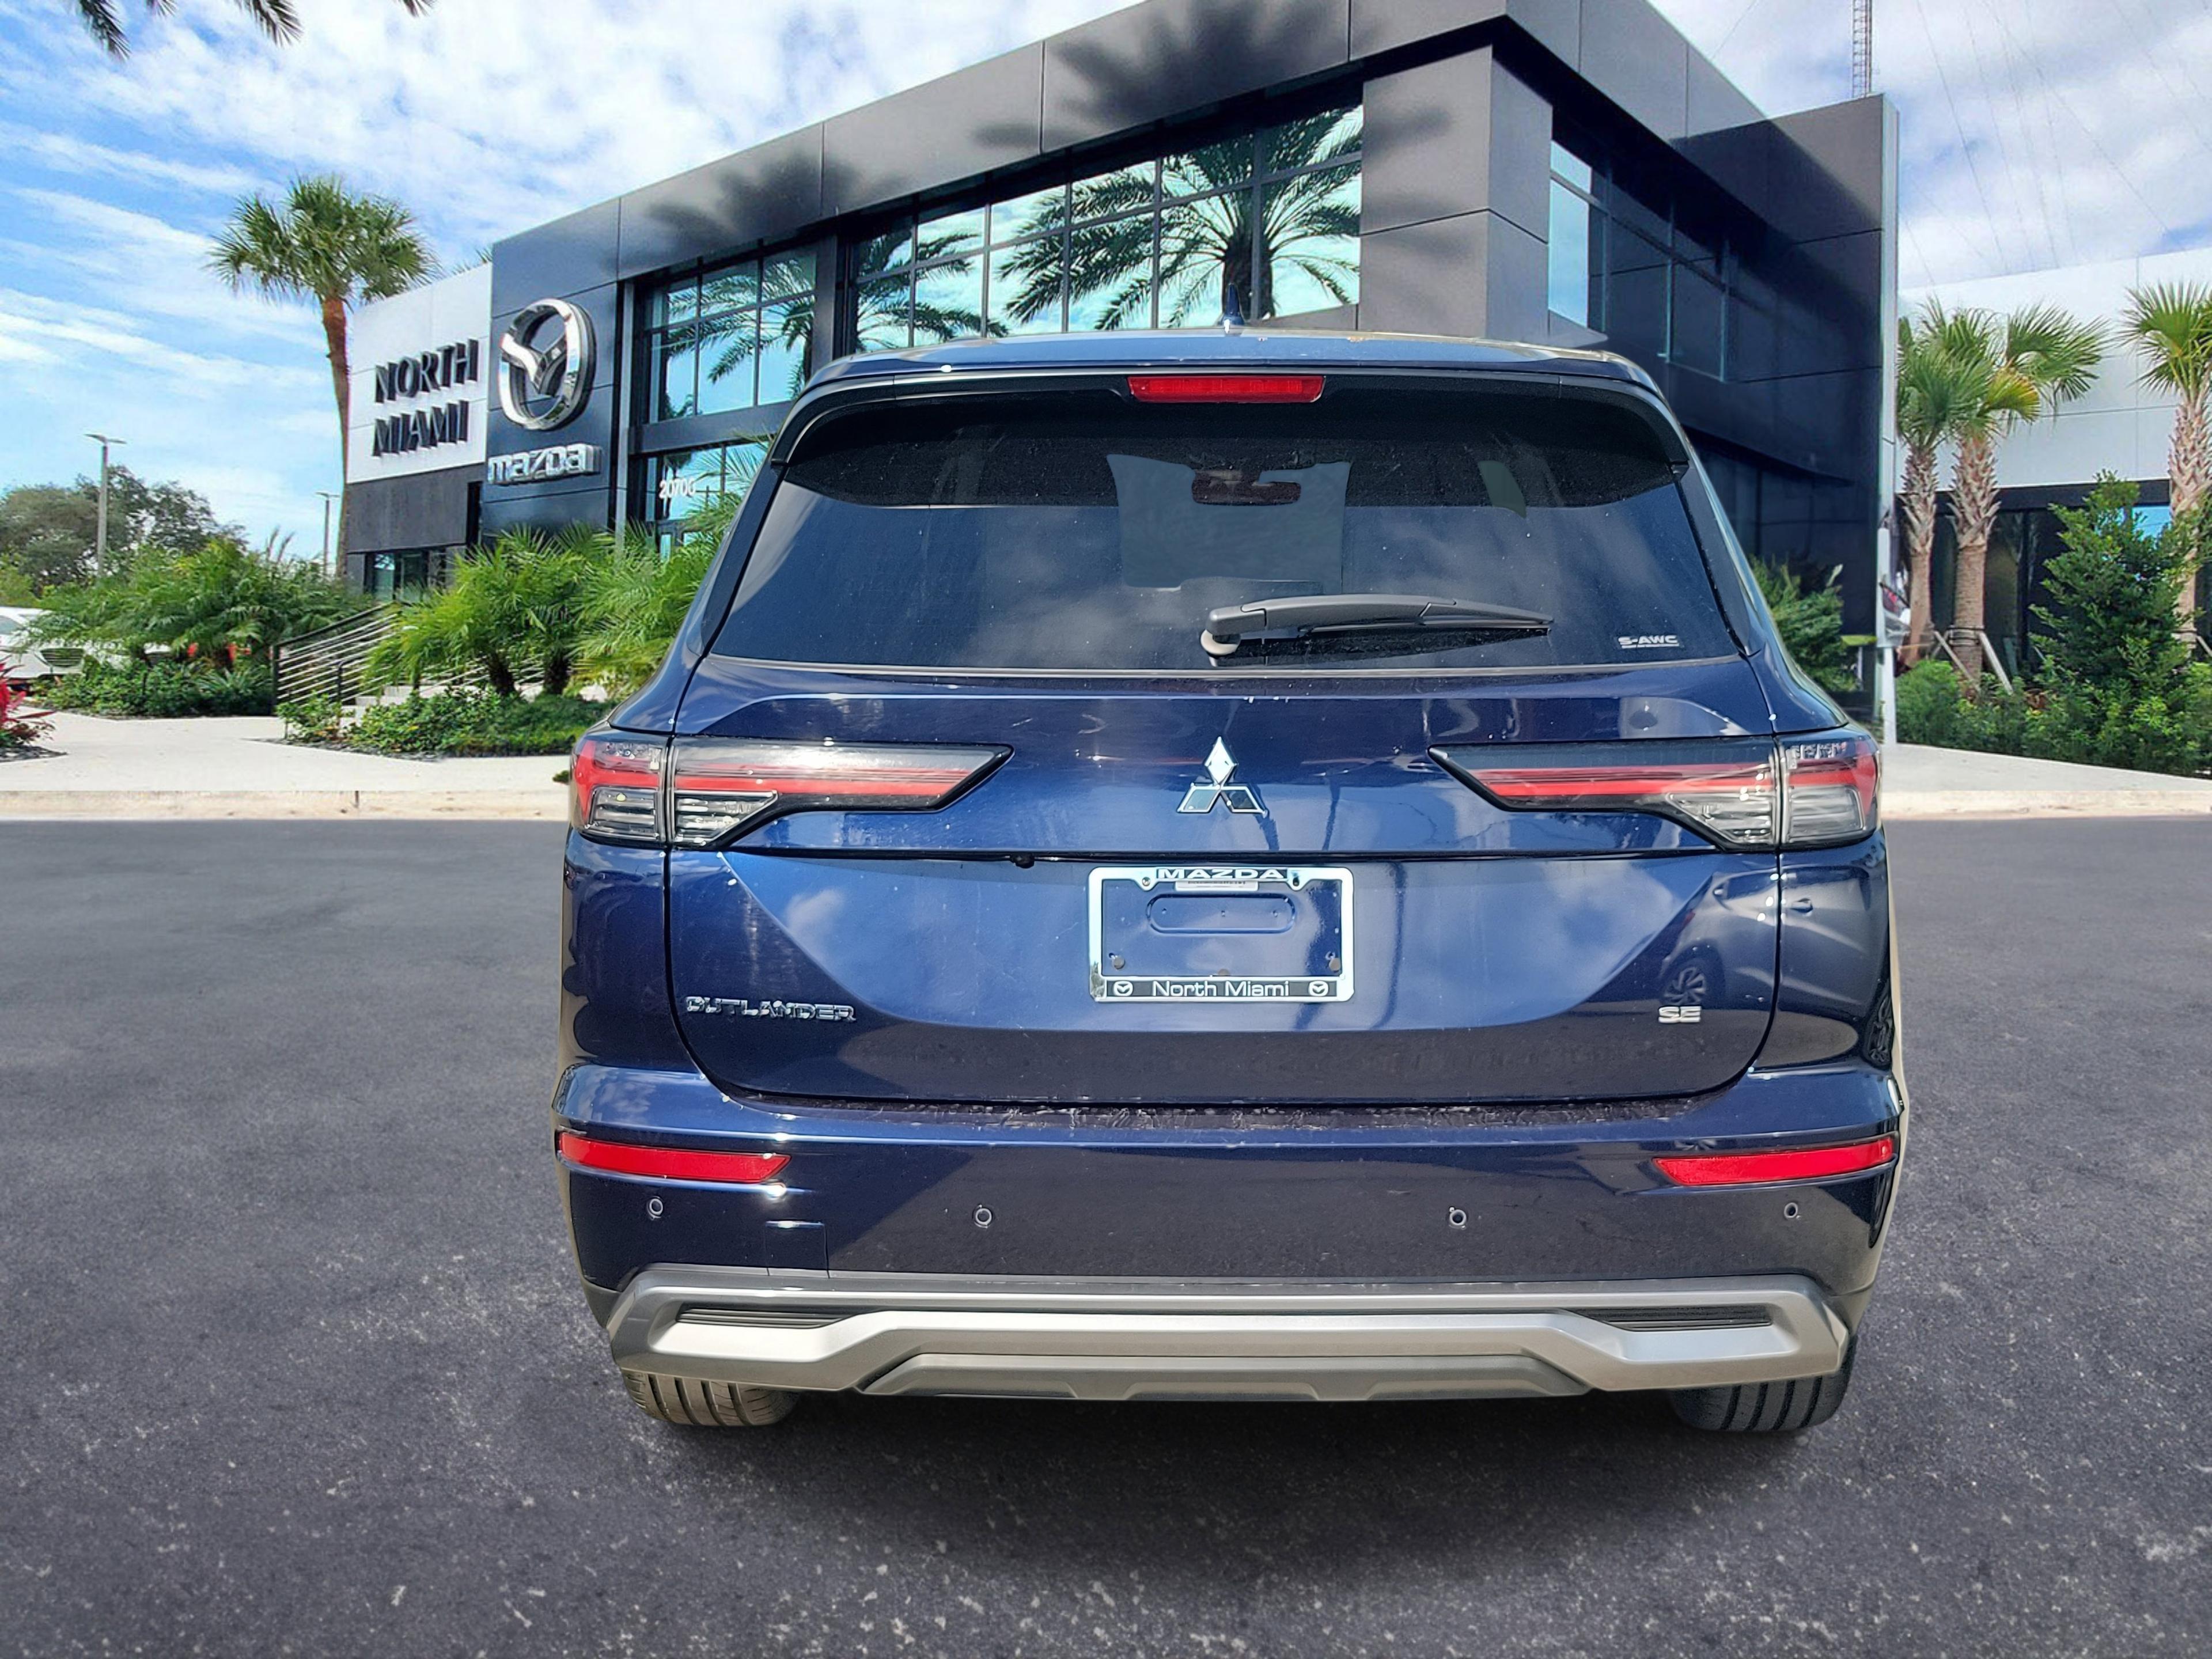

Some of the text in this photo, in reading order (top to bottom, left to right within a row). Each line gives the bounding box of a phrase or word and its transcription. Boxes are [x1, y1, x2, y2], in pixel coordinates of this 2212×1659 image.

[374, 338, 480, 404] NORTH
[373, 400, 469, 457] MIAMI
[1618, 635, 1678, 646] S-AWC
[1157, 868, 1285, 880] MAZDA
[1153, 981, 1290, 997] North Miami
[685, 996, 857, 1022] OUTLANDER
[1658, 1006, 1702, 1023] SE
